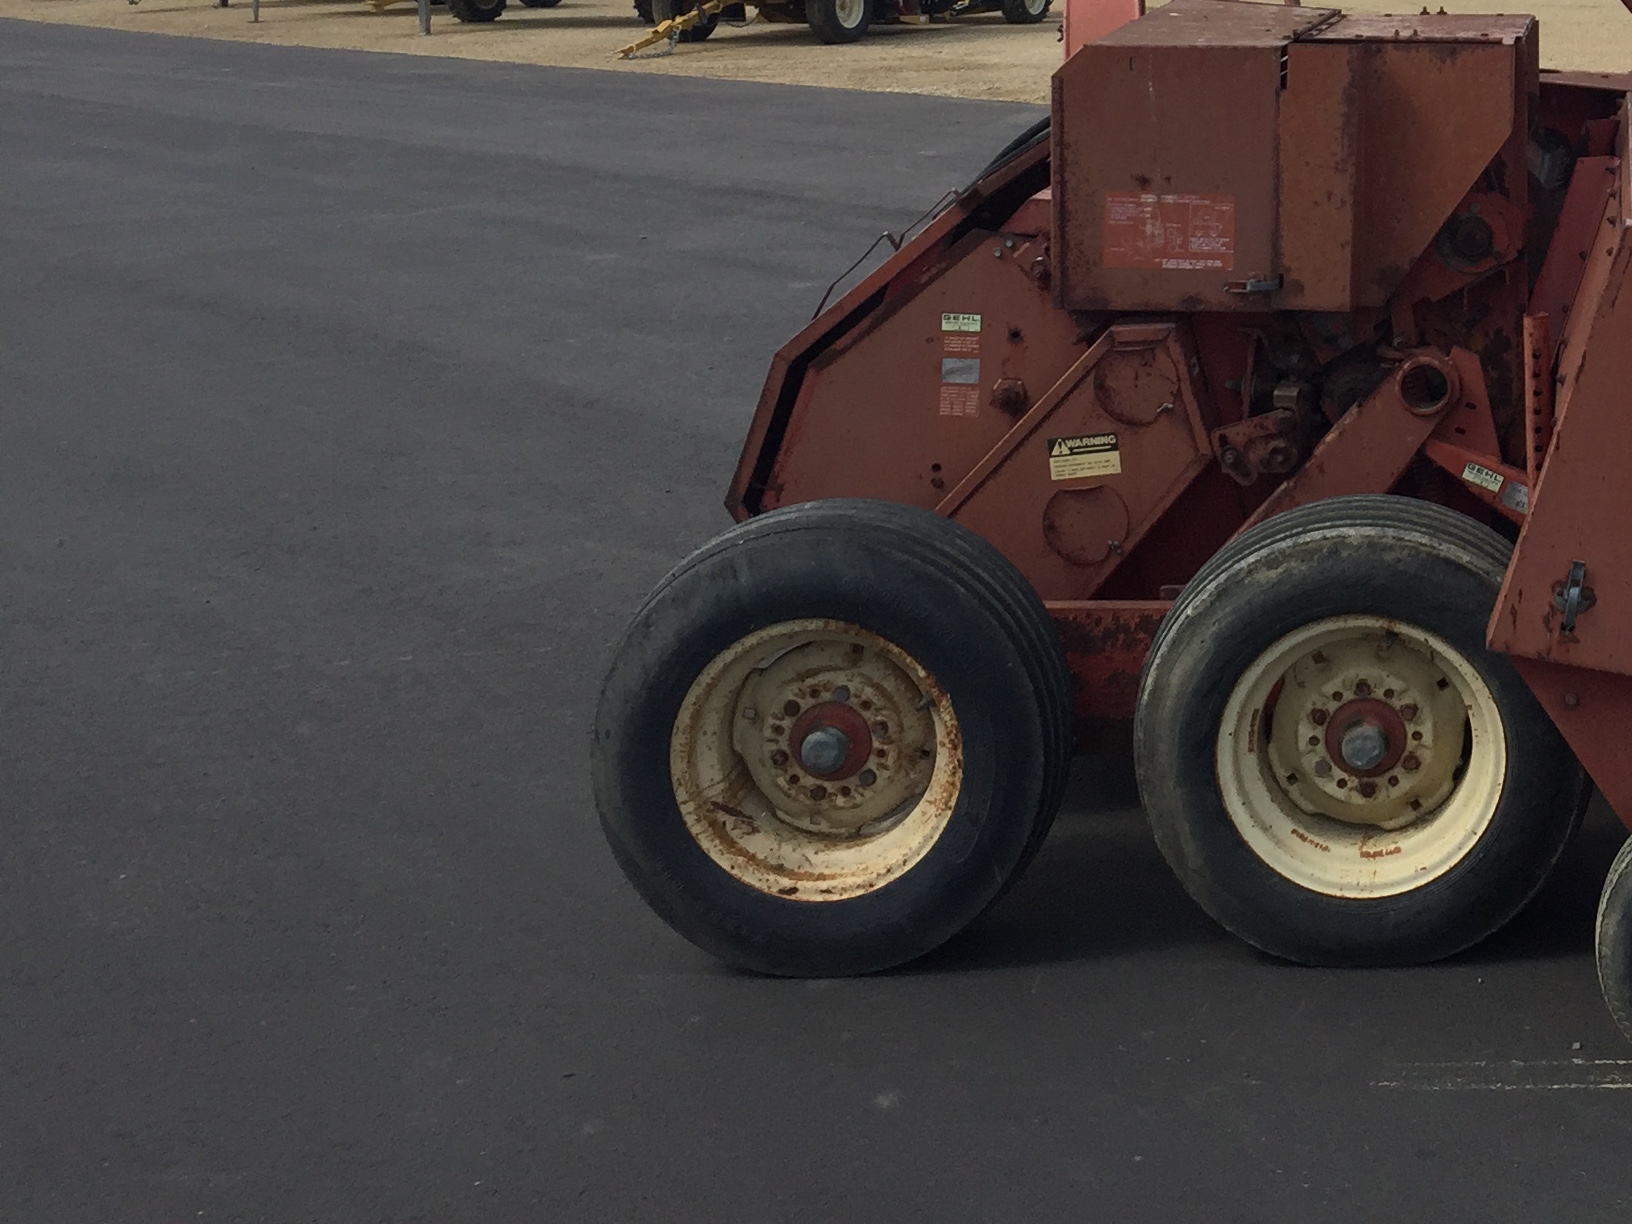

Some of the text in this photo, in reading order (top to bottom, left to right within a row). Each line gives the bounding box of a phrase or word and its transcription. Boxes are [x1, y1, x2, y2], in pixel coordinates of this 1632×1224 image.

[943, 314, 980, 322] GEHL
[1065, 435, 1117, 448] WARNING
[1467, 463, 1502, 483] GEHL
